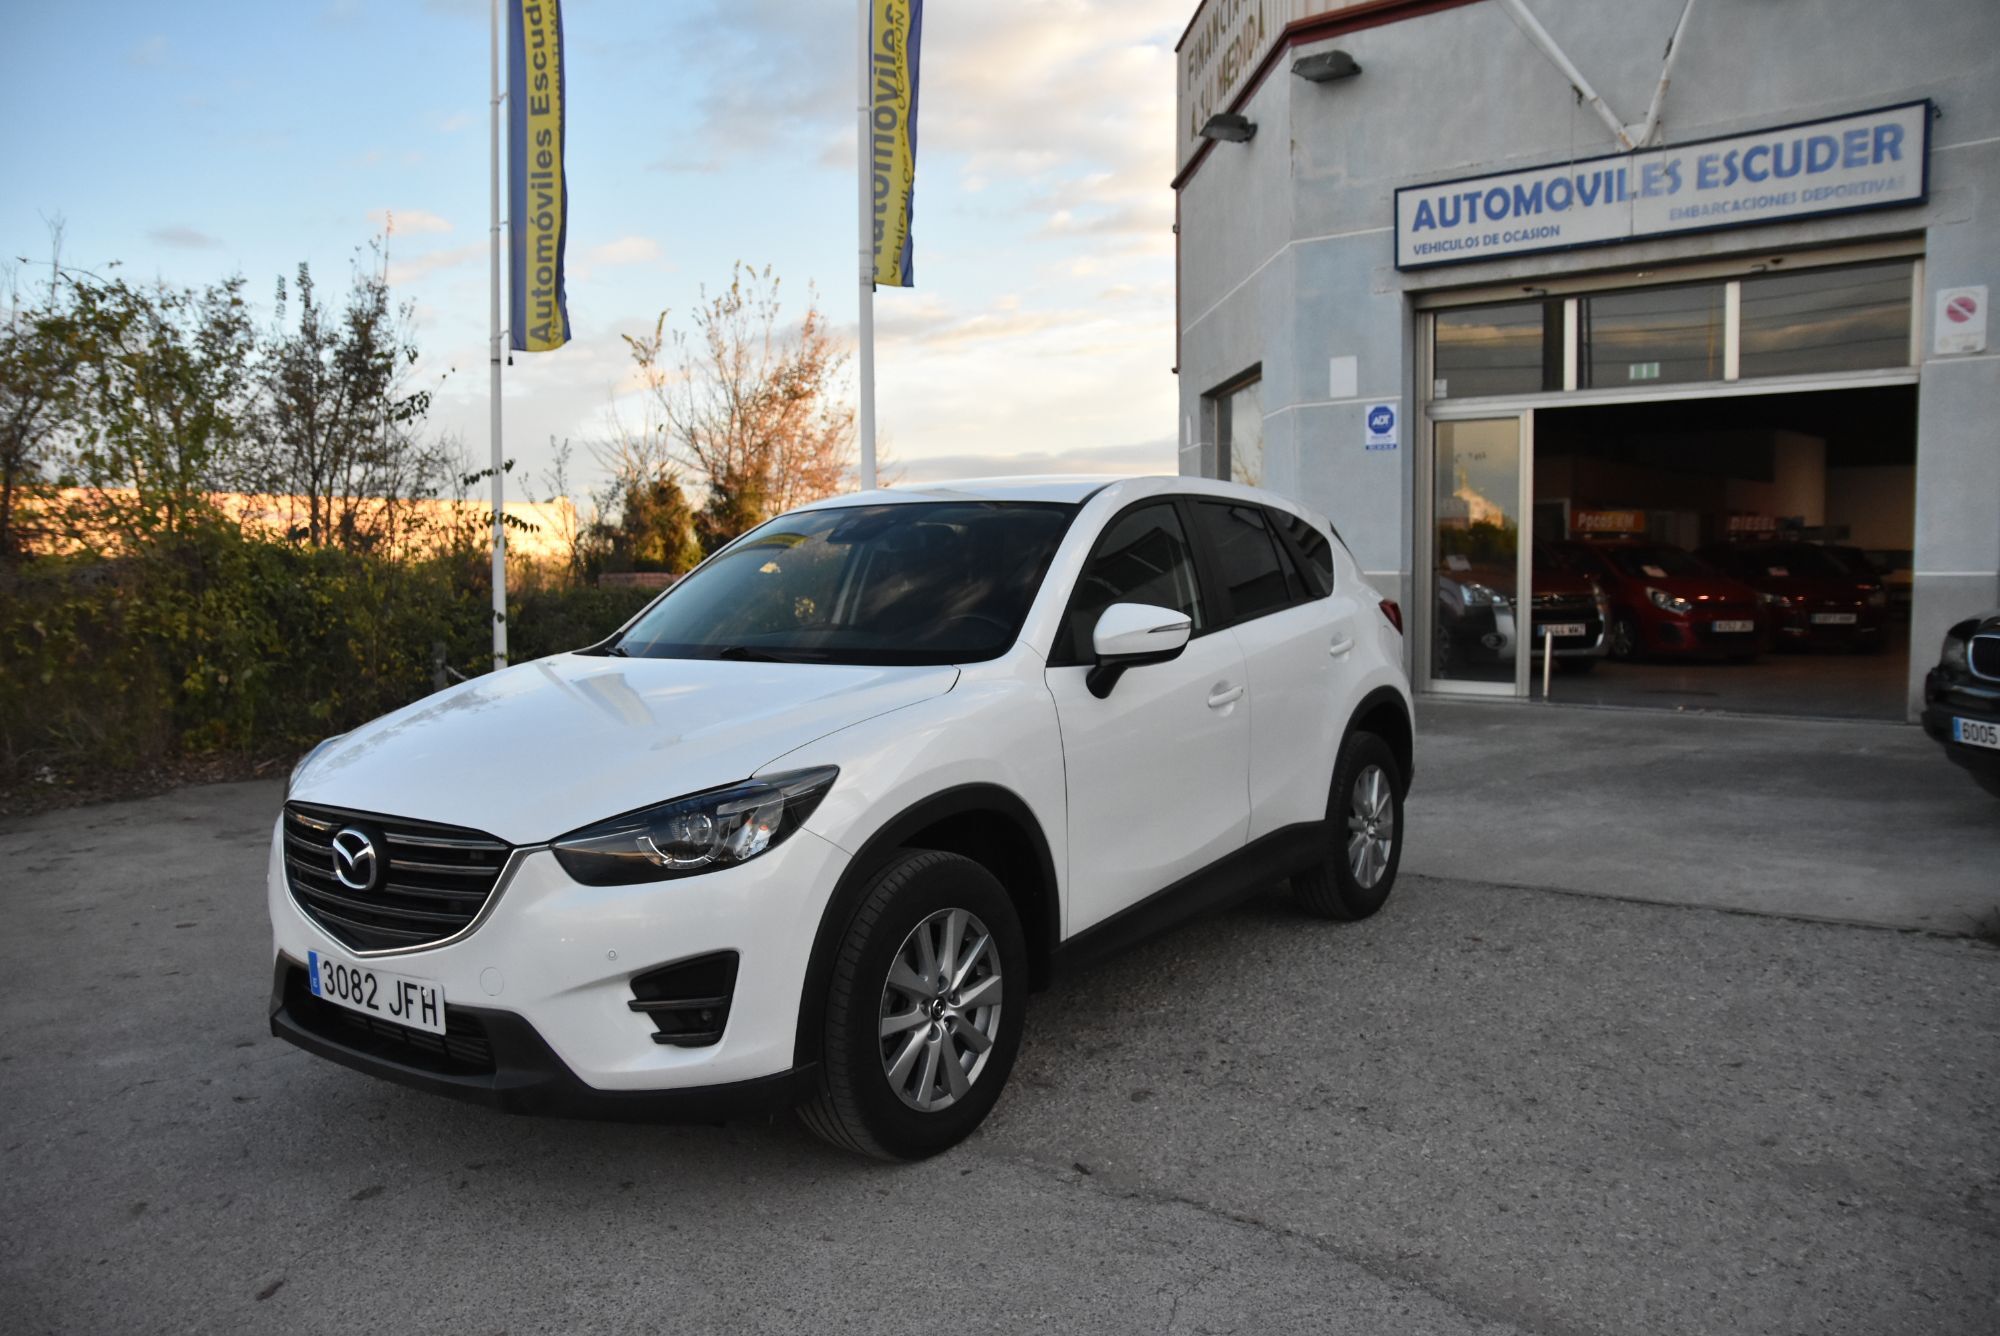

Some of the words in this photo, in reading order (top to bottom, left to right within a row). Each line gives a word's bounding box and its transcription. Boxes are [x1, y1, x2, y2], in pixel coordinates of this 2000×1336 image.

[524, 0, 550, 116] Escud
[1412, 157, 1682, 232] AUTOMOVILES
[1697, 122, 1906, 191] ESCUDER
[1669, 192, 1797, 221] EMBARCACIONES
[529, 128, 554, 343] Automóviles
[1413, 236, 1479, 256] VEHICULOS
[1483, 233, 1499, 246] DE
[1503, 225, 1561, 243] OCASION
[1371, 414, 1391, 426] ADT
[1962, 722, 1998, 745] 6005
[323, 960, 379, 1011] 3082
[389, 979, 438, 1027] JFH
